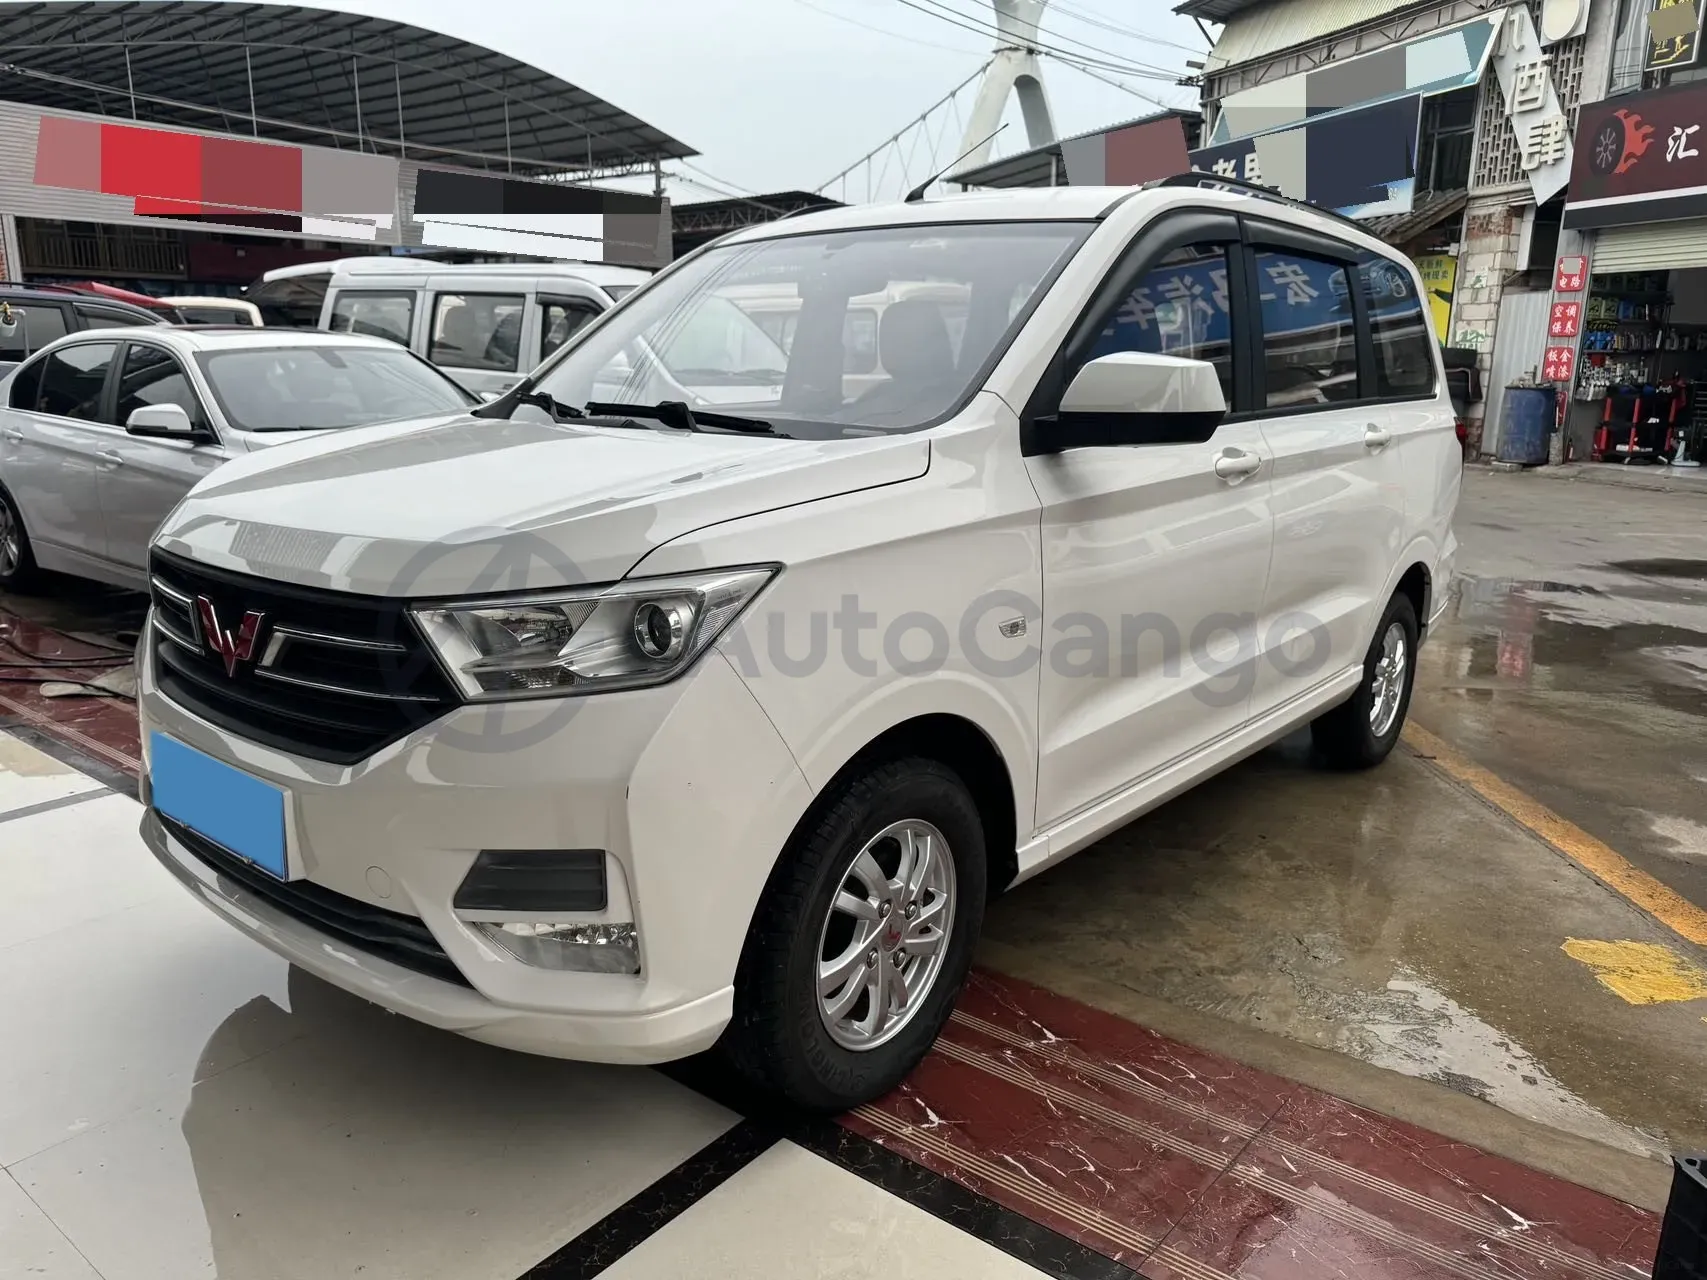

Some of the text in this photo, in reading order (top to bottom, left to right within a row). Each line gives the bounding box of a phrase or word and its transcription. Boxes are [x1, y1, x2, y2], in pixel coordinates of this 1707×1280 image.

[1666, 124, 1700, 162] 汇
[1554, 305, 1577, 318] 空调
[1552, 320, 1575, 334] 保养
[1545, 364, 1569, 378] 喷漆
